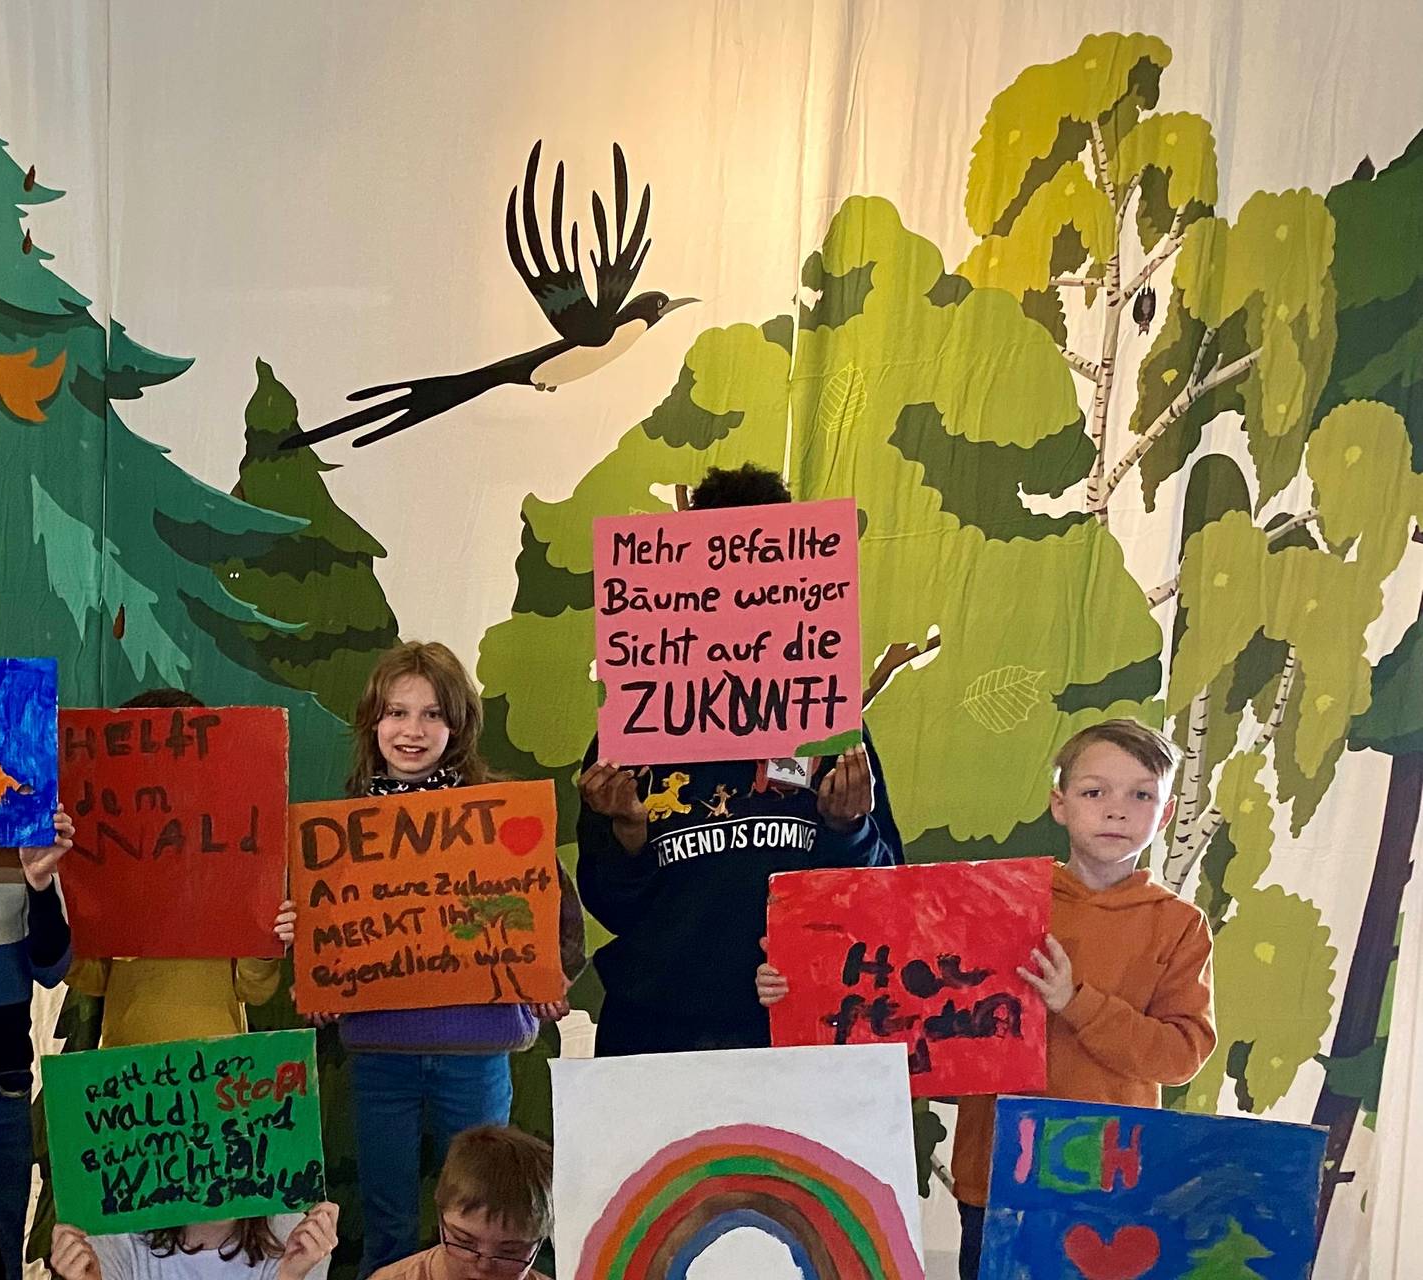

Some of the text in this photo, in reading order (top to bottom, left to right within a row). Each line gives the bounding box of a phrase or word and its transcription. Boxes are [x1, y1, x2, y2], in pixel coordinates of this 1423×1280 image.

[611, 526, 841, 571] Mehr gefällte
[600, 577, 851, 616] Bäume weniger
[604, 621, 842, 667] Sicht auf die
[299, 799, 507, 872] DENKT
[730, 823, 749, 849] IS
[309, 879, 360, 909] An
[313, 907, 427, 954] MERKT
[1012, 1117, 1144, 1193] ICH
